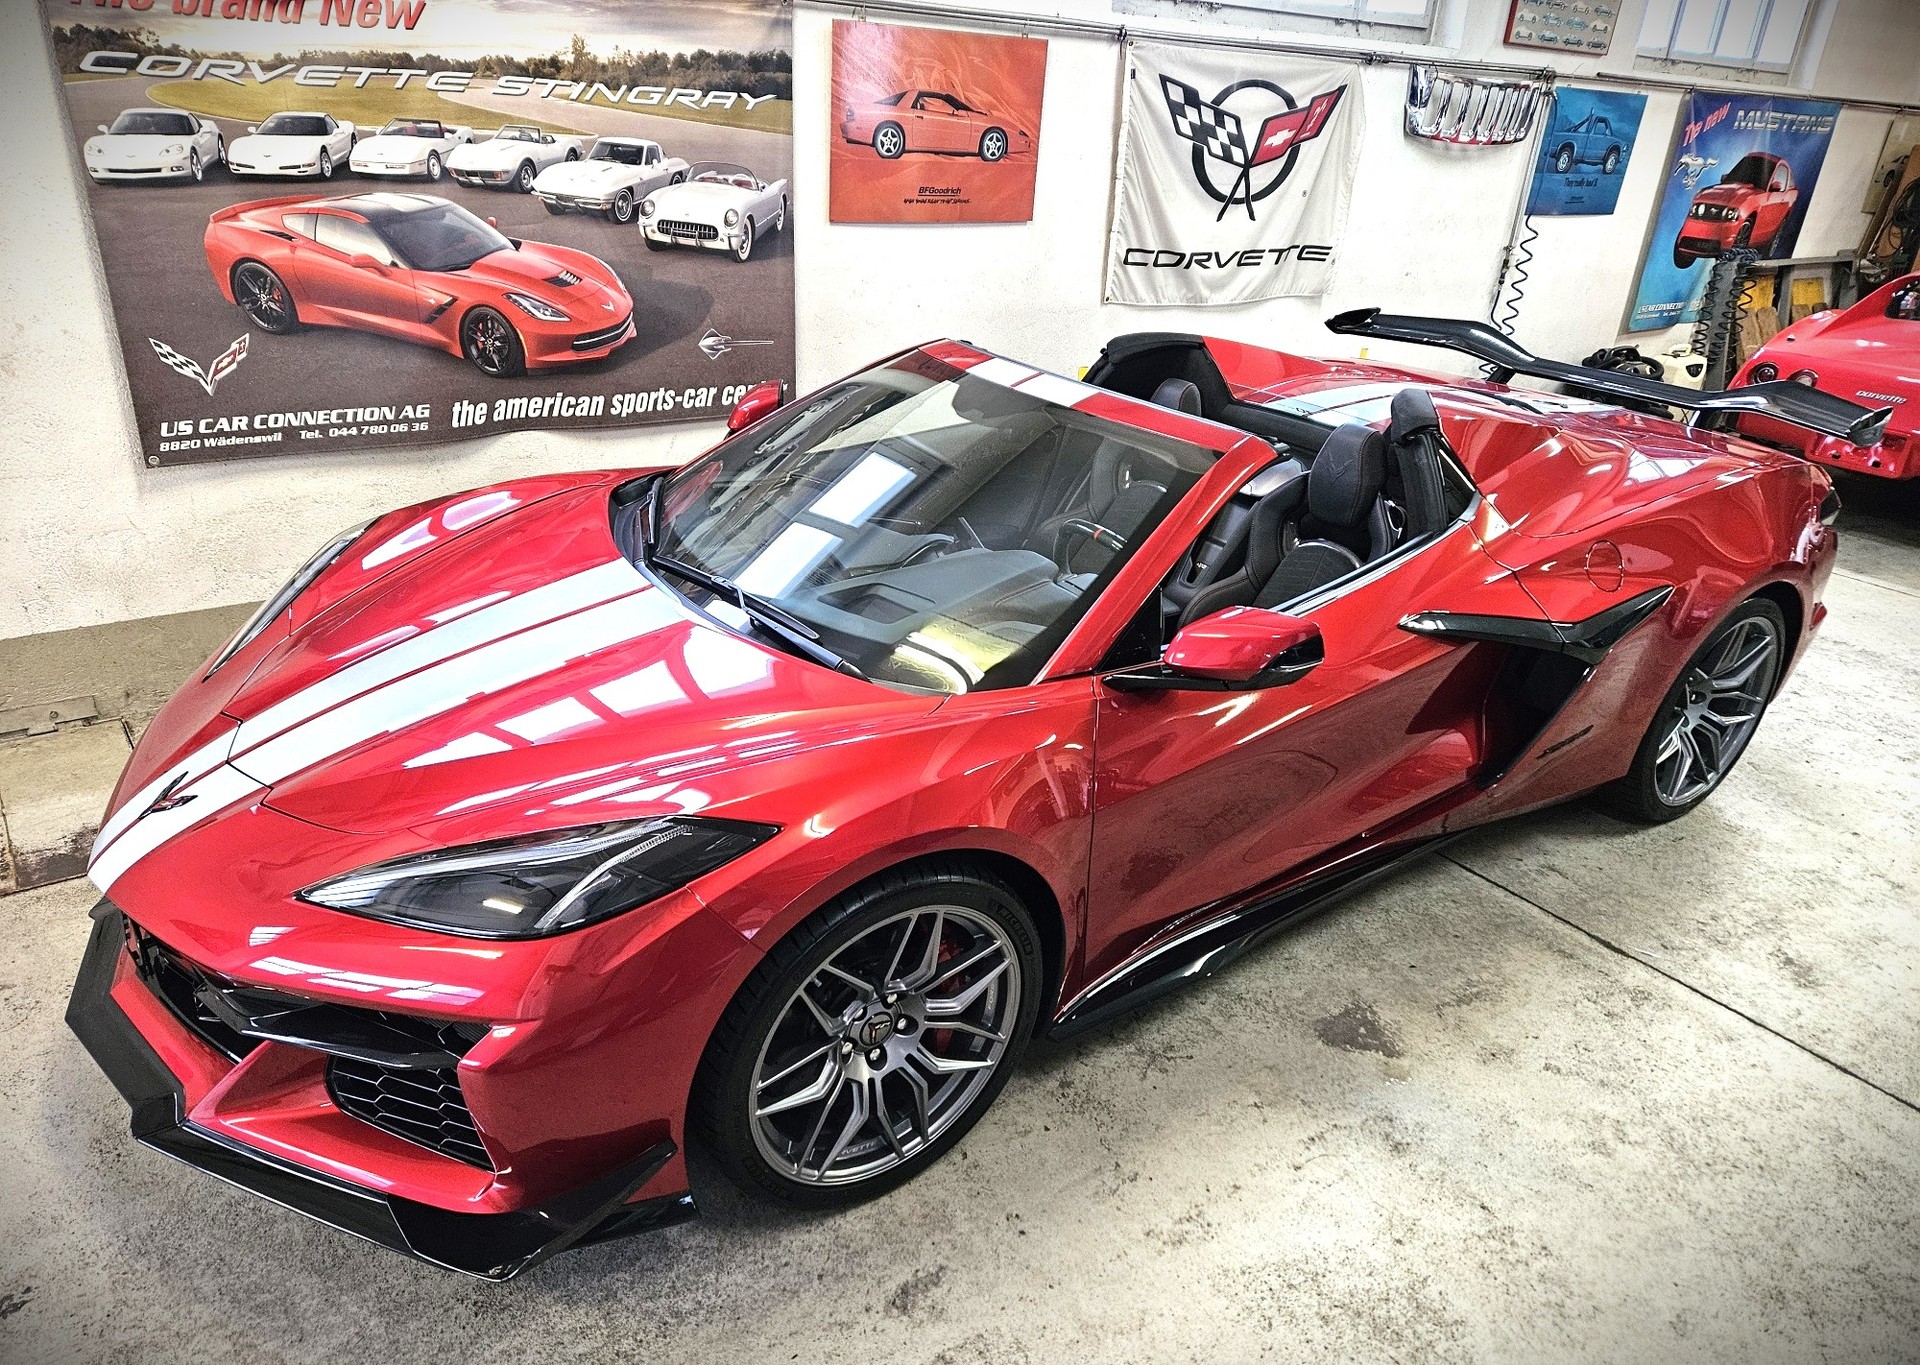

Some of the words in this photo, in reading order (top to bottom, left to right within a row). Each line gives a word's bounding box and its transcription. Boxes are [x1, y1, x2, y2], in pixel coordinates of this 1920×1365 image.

[319, 0, 427, 30] New
[79, 50, 474, 92] CORVETTE
[492, 75, 777, 111] STINGRAY
[1733, 109, 1834, 135] MUSTANG
[918, 186, 962, 195] BFGoodrich
[1123, 244, 1333, 270] CORVETTE
[160, 420, 193, 438] US
[199, 416, 249, 434] CAR
[253, 406, 396, 430] CONNECTION
[399, 403, 431, 419] AG
[451, 399, 487, 428] the
[492, 391, 604, 422] american
[610, 386, 717, 417] sports-car
[160, 439, 201, 452] 8820
[203, 432, 282, 447] Wädenswil
[299, 430, 323, 440] Tel.
[328, 426, 358, 438] 044
[360, 424, 387, 435] 780
[389, 422, 409, 433] 06
[411, 421, 430, 432] 36
